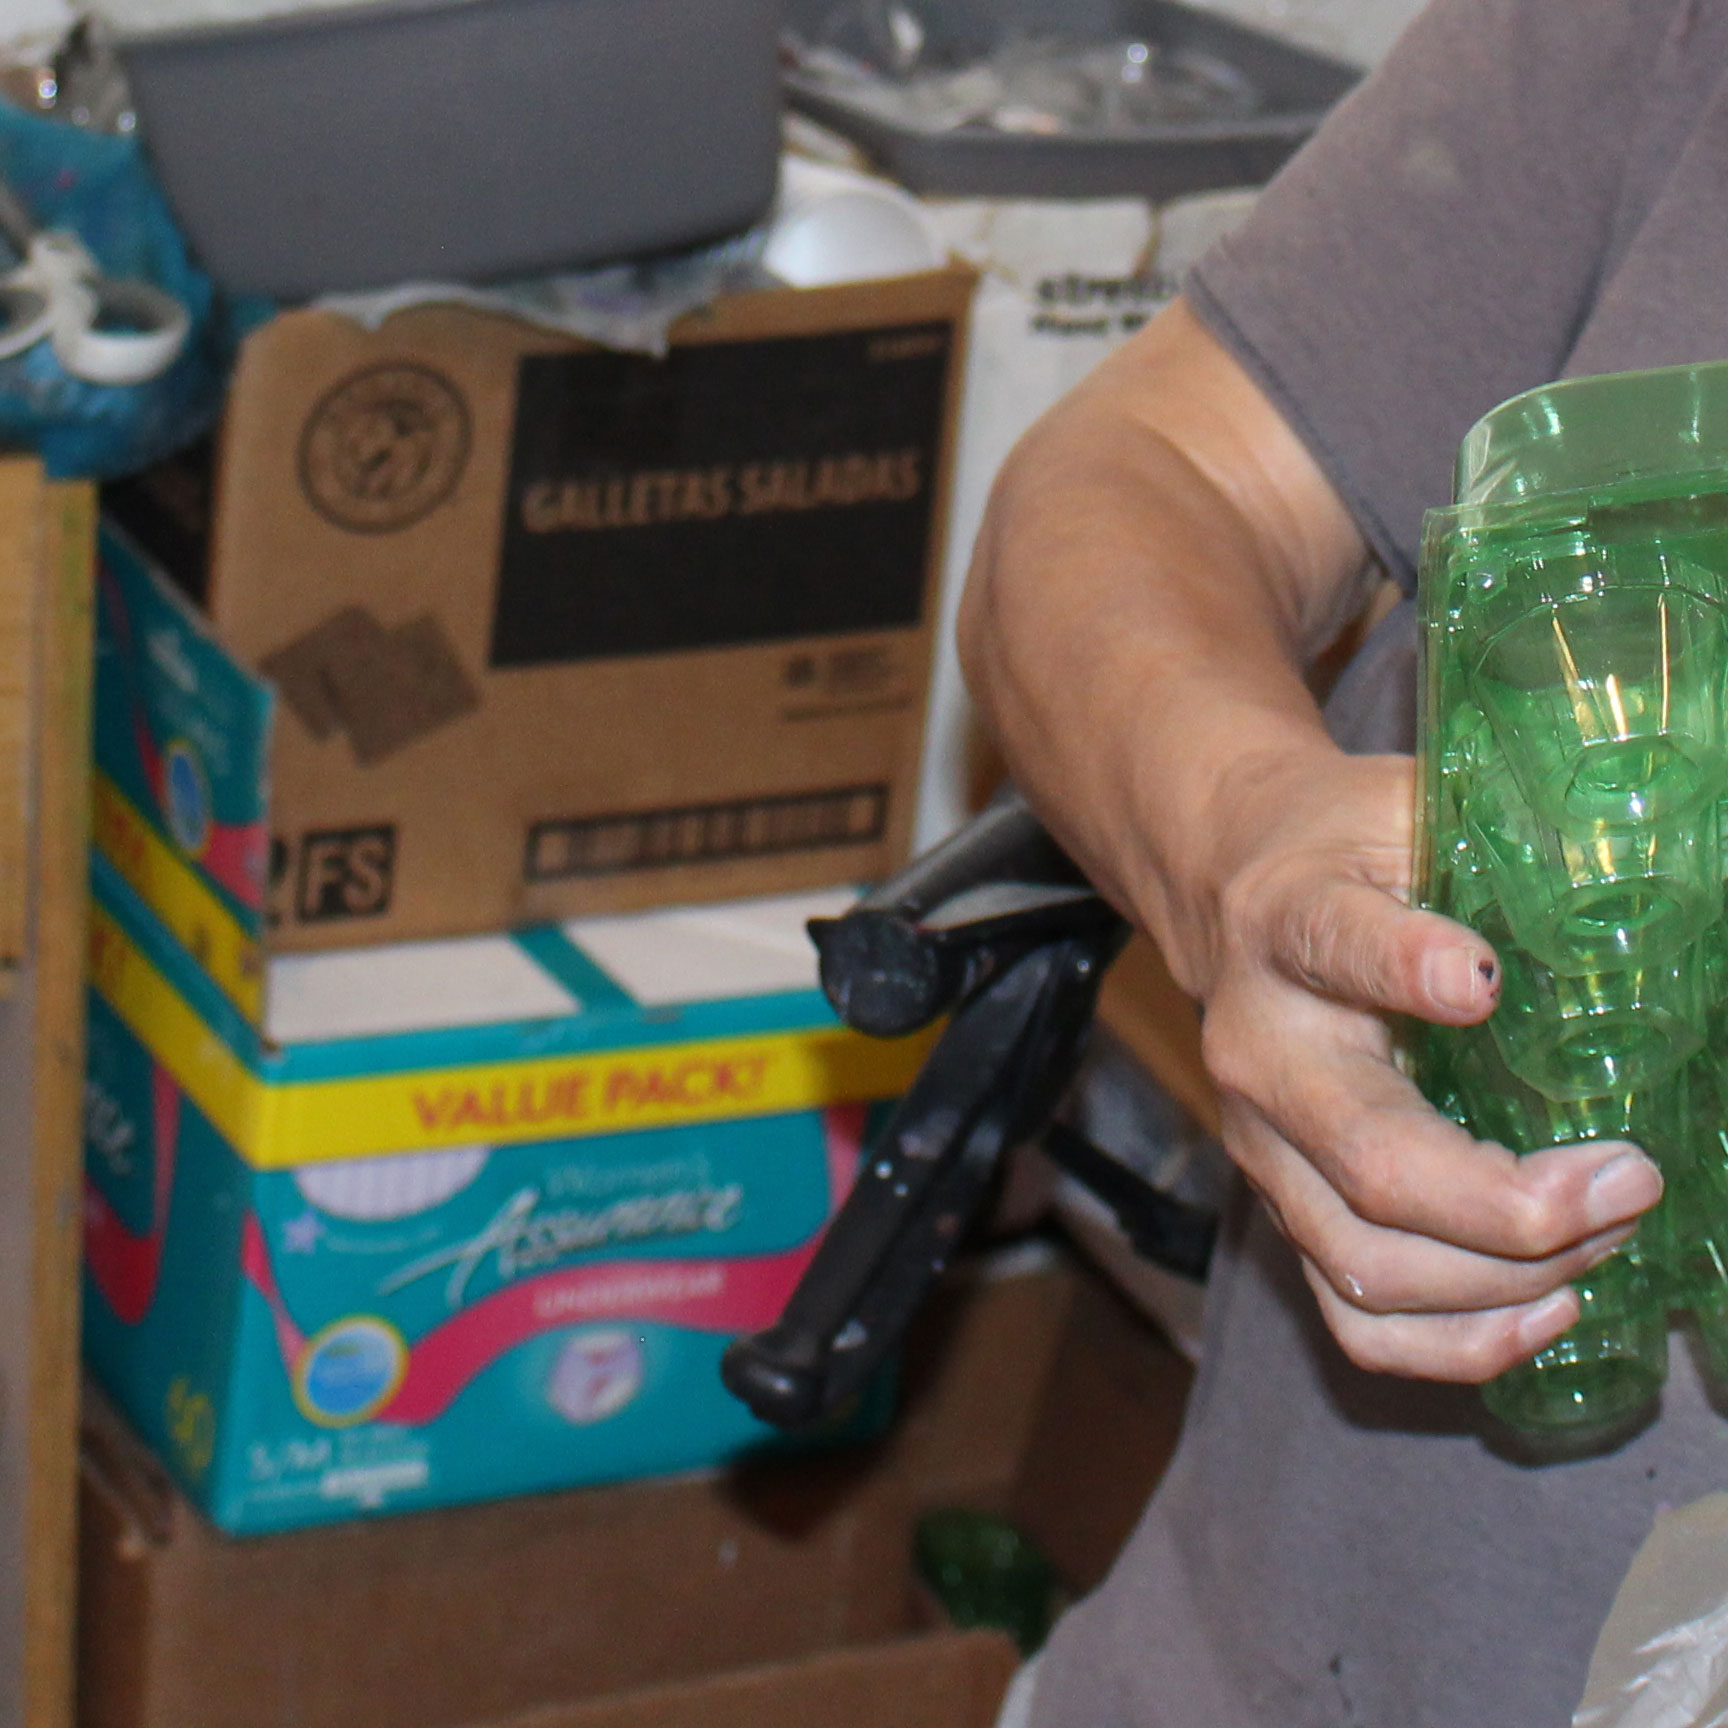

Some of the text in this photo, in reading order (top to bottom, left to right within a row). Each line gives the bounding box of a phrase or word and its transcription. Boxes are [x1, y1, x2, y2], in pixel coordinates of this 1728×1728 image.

[522, 450, 920, 534] GALLETAS SALADAS
[412, 1069, 586, 1130] VALUE
